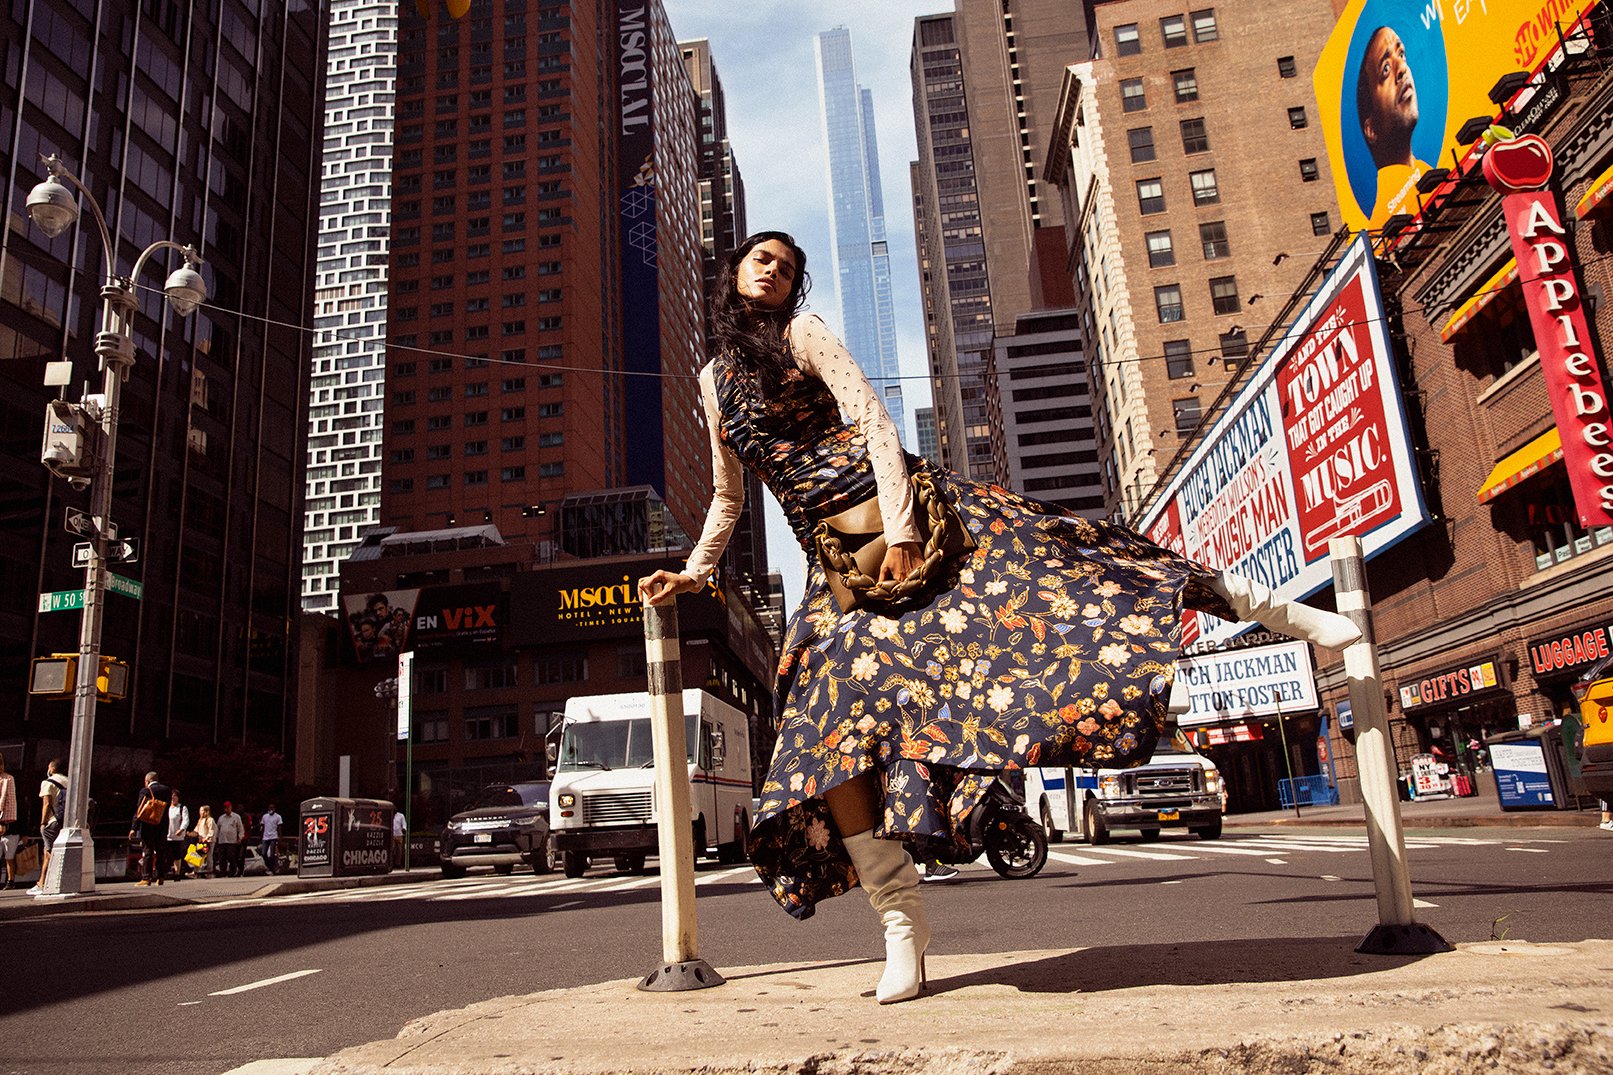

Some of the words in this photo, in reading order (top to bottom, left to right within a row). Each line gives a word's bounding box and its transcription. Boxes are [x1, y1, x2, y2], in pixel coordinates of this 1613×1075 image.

[1297, 338, 1317, 367] AND
[1315, 314, 1338, 346] THE
[1287, 319, 1360, 418] TOWN
[1287, 416, 1309, 451] THAT
[1308, 402, 1326, 435] GOT
[1324, 371, 1360, 422] CAUGHT
[1358, 358, 1374, 392] UP
[1315, 436, 1329, 453] IN
[1327, 414, 1350, 443] THE
[1181, 458, 1213, 525] HUGH
[1211, 390, 1274, 496] JACKMAN
[1197, 495, 1229, 541] MEREDITH
[1226, 453, 1267, 515] WILLSON'S
[1212, 504, 1253, 571] MUSIC
[1250, 470, 1290, 544] MAN
[52, 594, 61, 609] W
[64, 592, 76, 608] 50
[111, 575, 142, 600] Broadway
[416, 615, 438, 630] EN
[442, 604, 496, 630] ViX
[558, 611, 591, 620] HOTEL
[609, 607, 632, 616] NEW
[1215, 652, 1298, 683] JACKMAN
[1531, 628, 1609, 674] LUGGAGE
[1238, 680, 1305, 709] FOSTER
[1420, 668, 1471, 703] GIFTS
[304, 816, 328, 835] 25
[343, 849, 389, 866] CHICAGO
